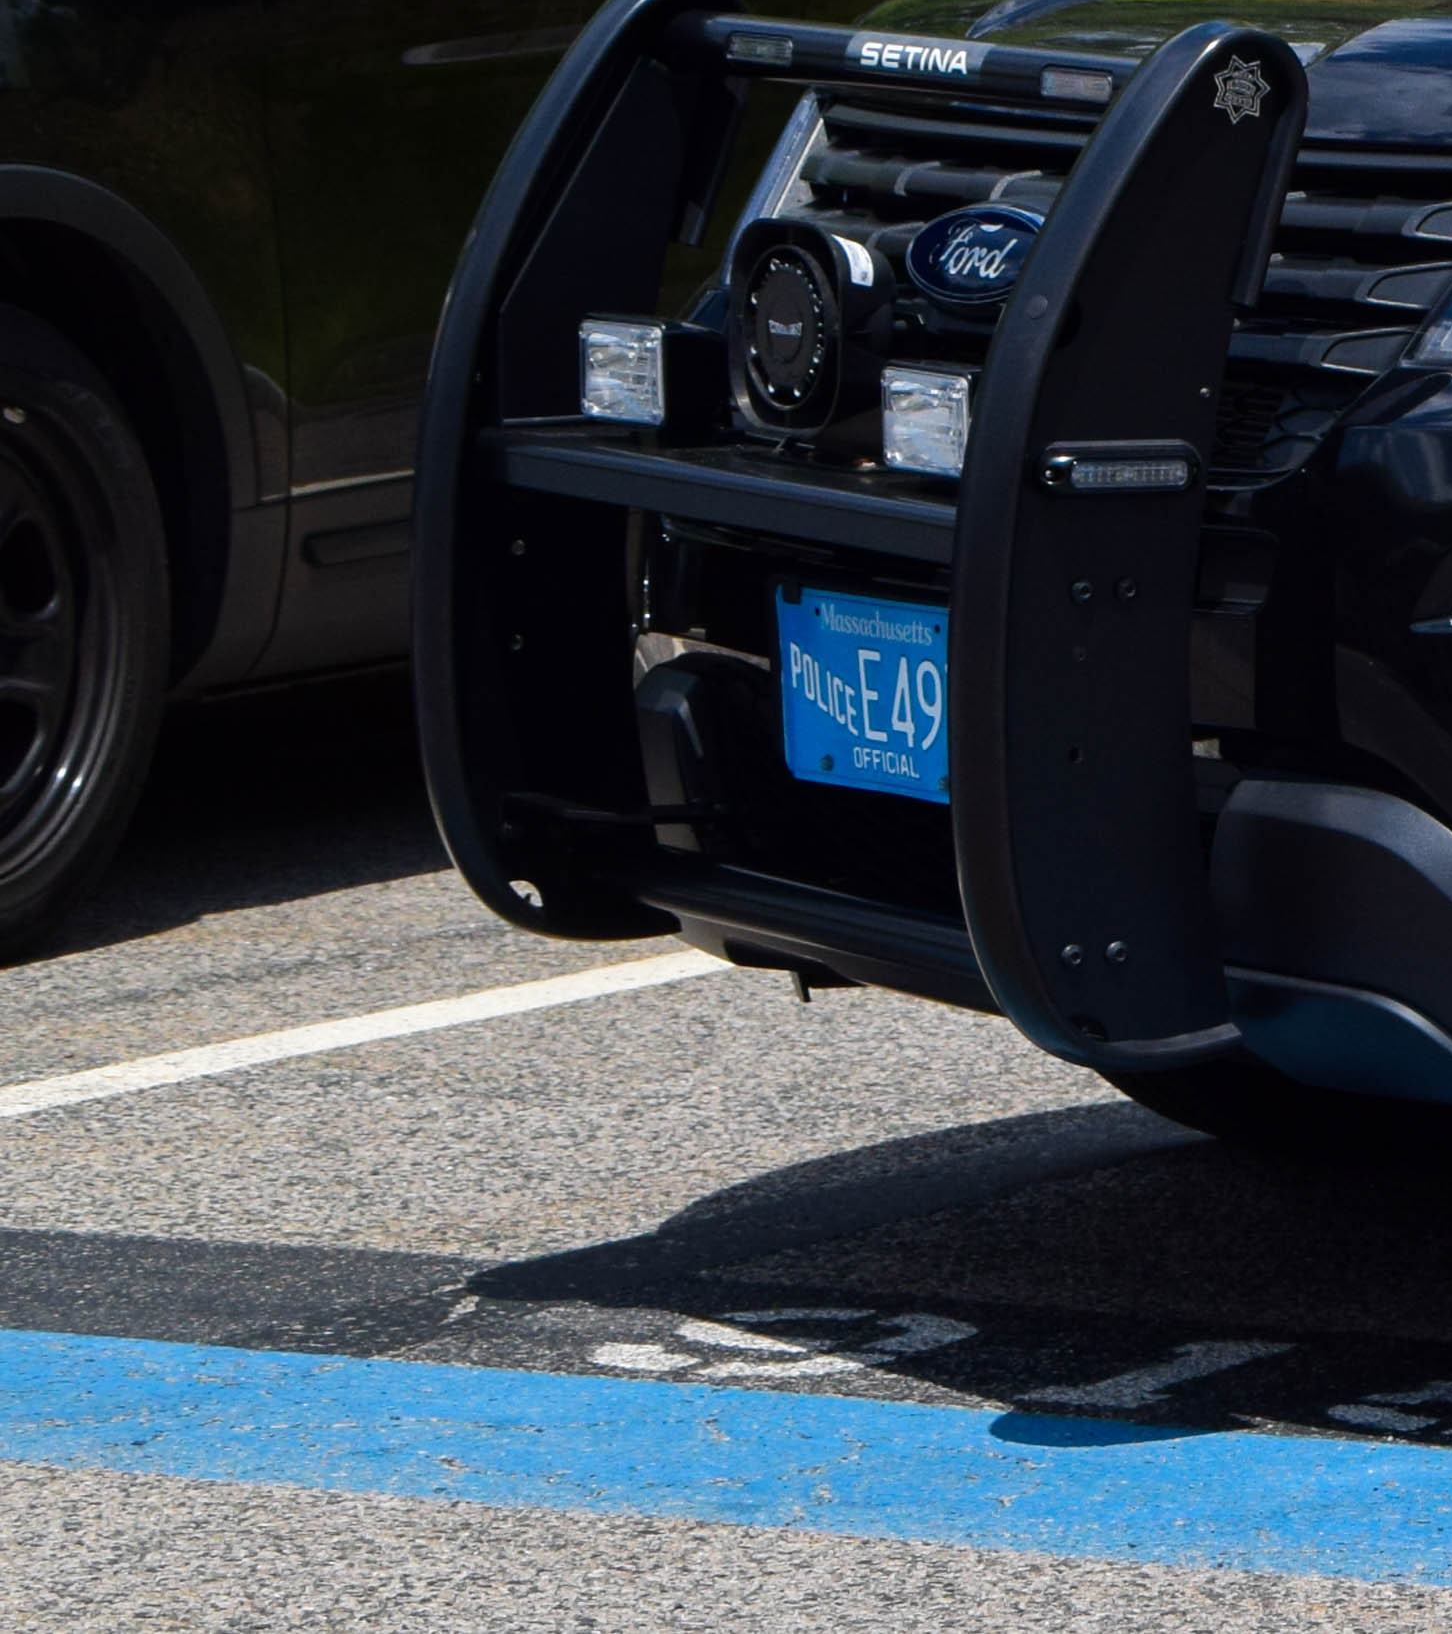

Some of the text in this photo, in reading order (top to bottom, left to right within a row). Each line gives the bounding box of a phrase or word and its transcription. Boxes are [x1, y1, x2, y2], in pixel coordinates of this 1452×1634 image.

[860, 41, 968, 75] SETINA
[931, 218, 1019, 280] Ford
[820, 602, 933, 646] Massachusetts
[789, 641, 949, 752] POLICE E49
[853, 745, 921, 779] OFFICIAL
